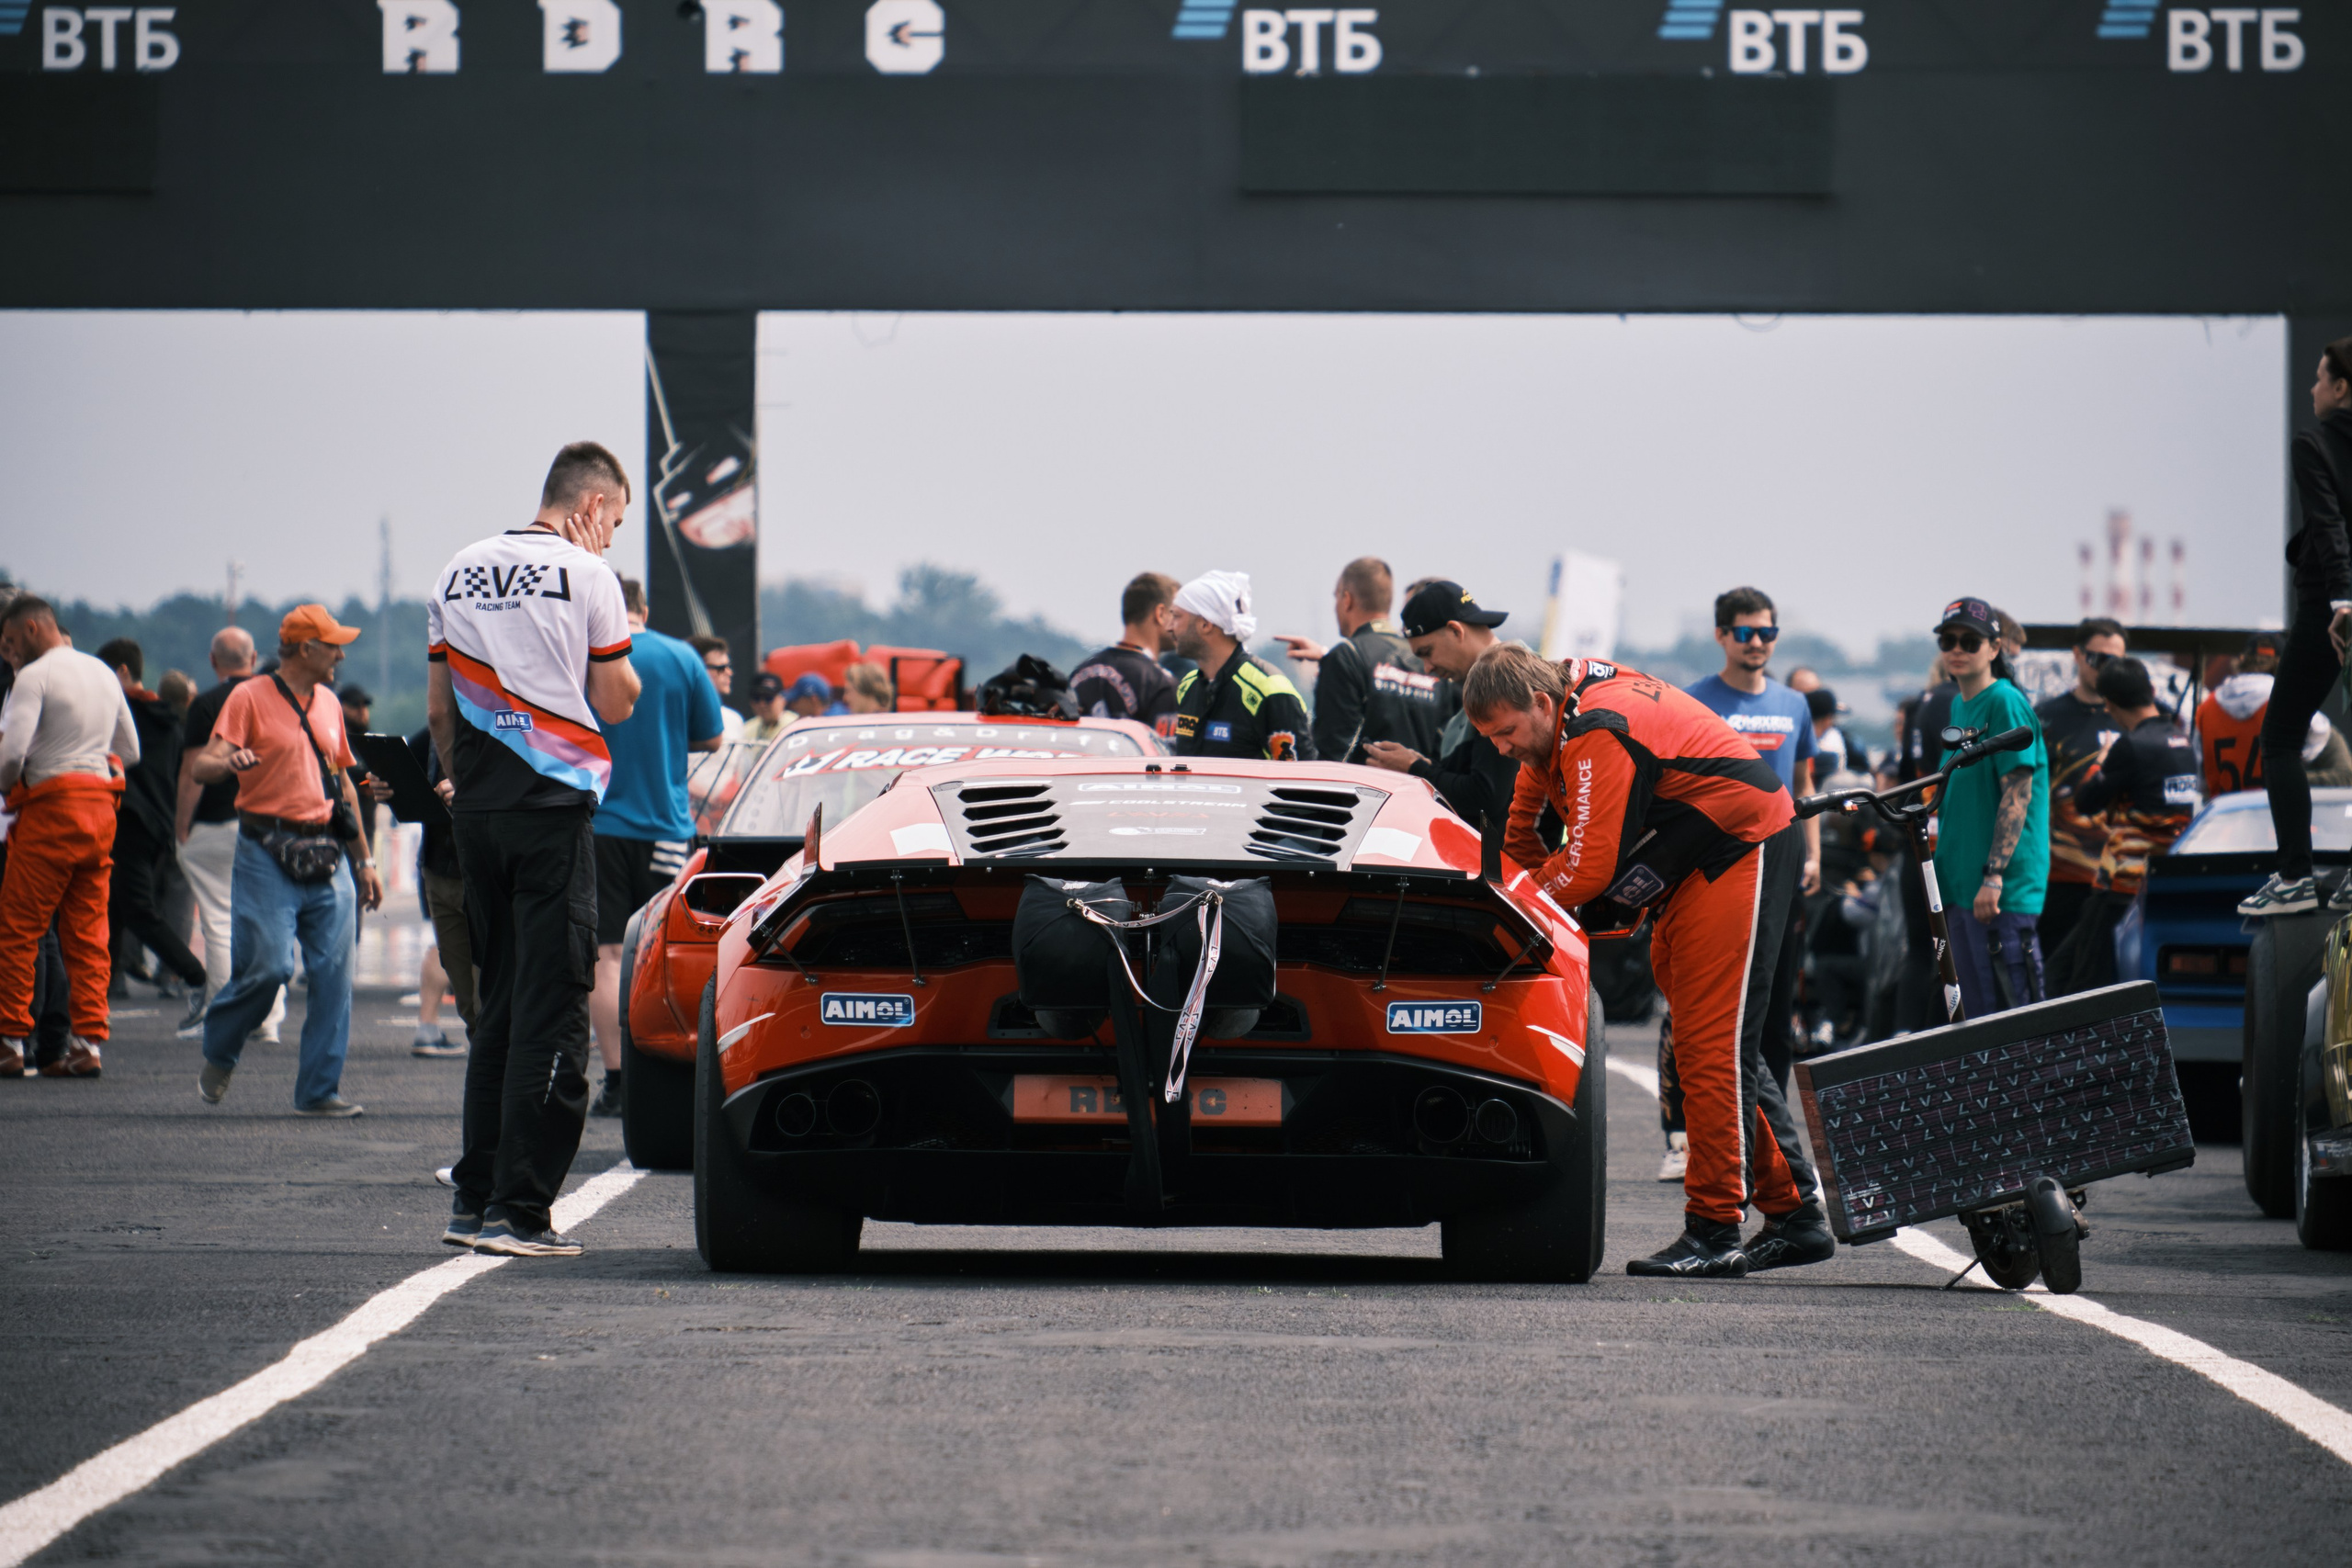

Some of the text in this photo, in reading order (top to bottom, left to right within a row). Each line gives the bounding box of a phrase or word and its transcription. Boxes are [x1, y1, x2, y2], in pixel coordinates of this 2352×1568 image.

[41, 8, 180, 71] ВТБ
[1242, 9, 1383, 73] ВТБ
[1728, 9, 1869, 73] ВТБ
[2166, 9, 2305, 72] ВТБ
[475, 600, 521, 611] RACING TEAM
[496, 714, 530, 728] AIML
[831, 746, 972, 770] RACE
[1566, 758, 1593, 873] ERFORMANCE
[1544, 872, 1574, 897] EVEL
[824, 999, 910, 1021] AIMOL
[1390, 1009, 1477, 1027] AIMOL
[1069, 1087, 1227, 1115] RDC
